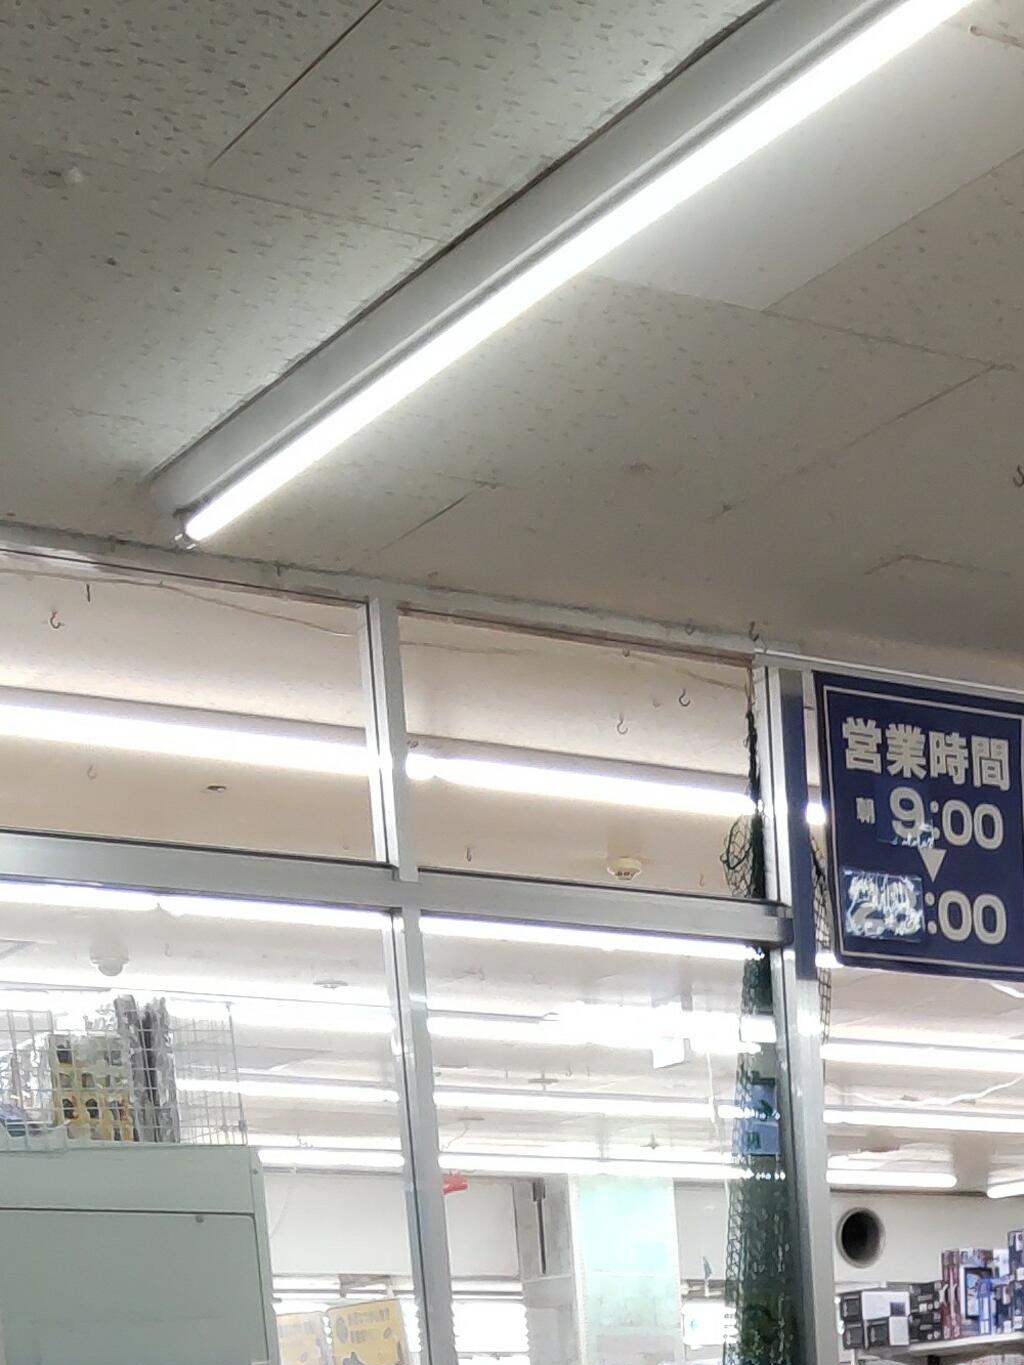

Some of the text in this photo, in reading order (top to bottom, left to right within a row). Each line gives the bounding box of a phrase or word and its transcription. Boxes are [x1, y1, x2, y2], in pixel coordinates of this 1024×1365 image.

[842, 716, 1010, 791] 営業時間
[890, 787, 1003, 849] 9:00
